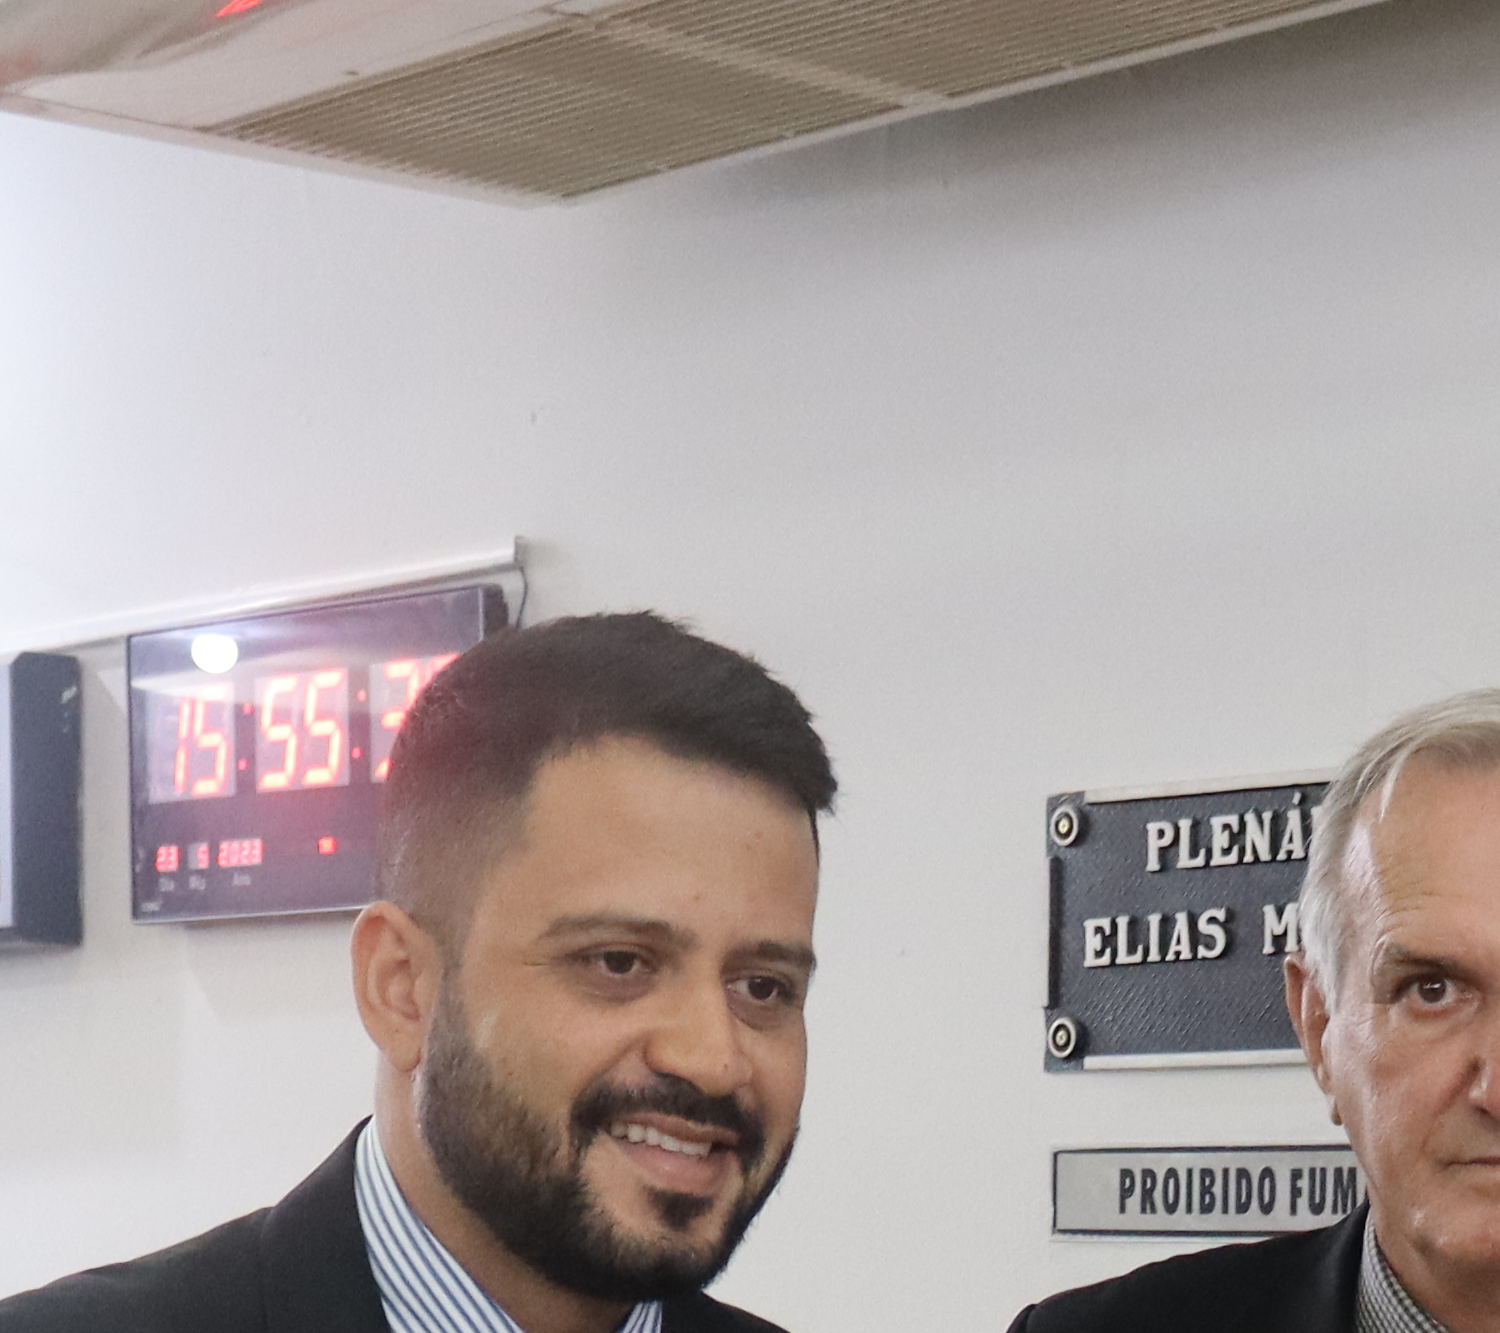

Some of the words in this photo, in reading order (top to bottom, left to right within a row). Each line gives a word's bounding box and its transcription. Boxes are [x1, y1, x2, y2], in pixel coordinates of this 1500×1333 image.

[217, 838, 263, 867] 2023
[1145, 791, 1322, 872] PLENÁ
[1083, 904, 1228, 968] ELIAS
[1119, 1166, 1276, 1215] PROIBIDO
